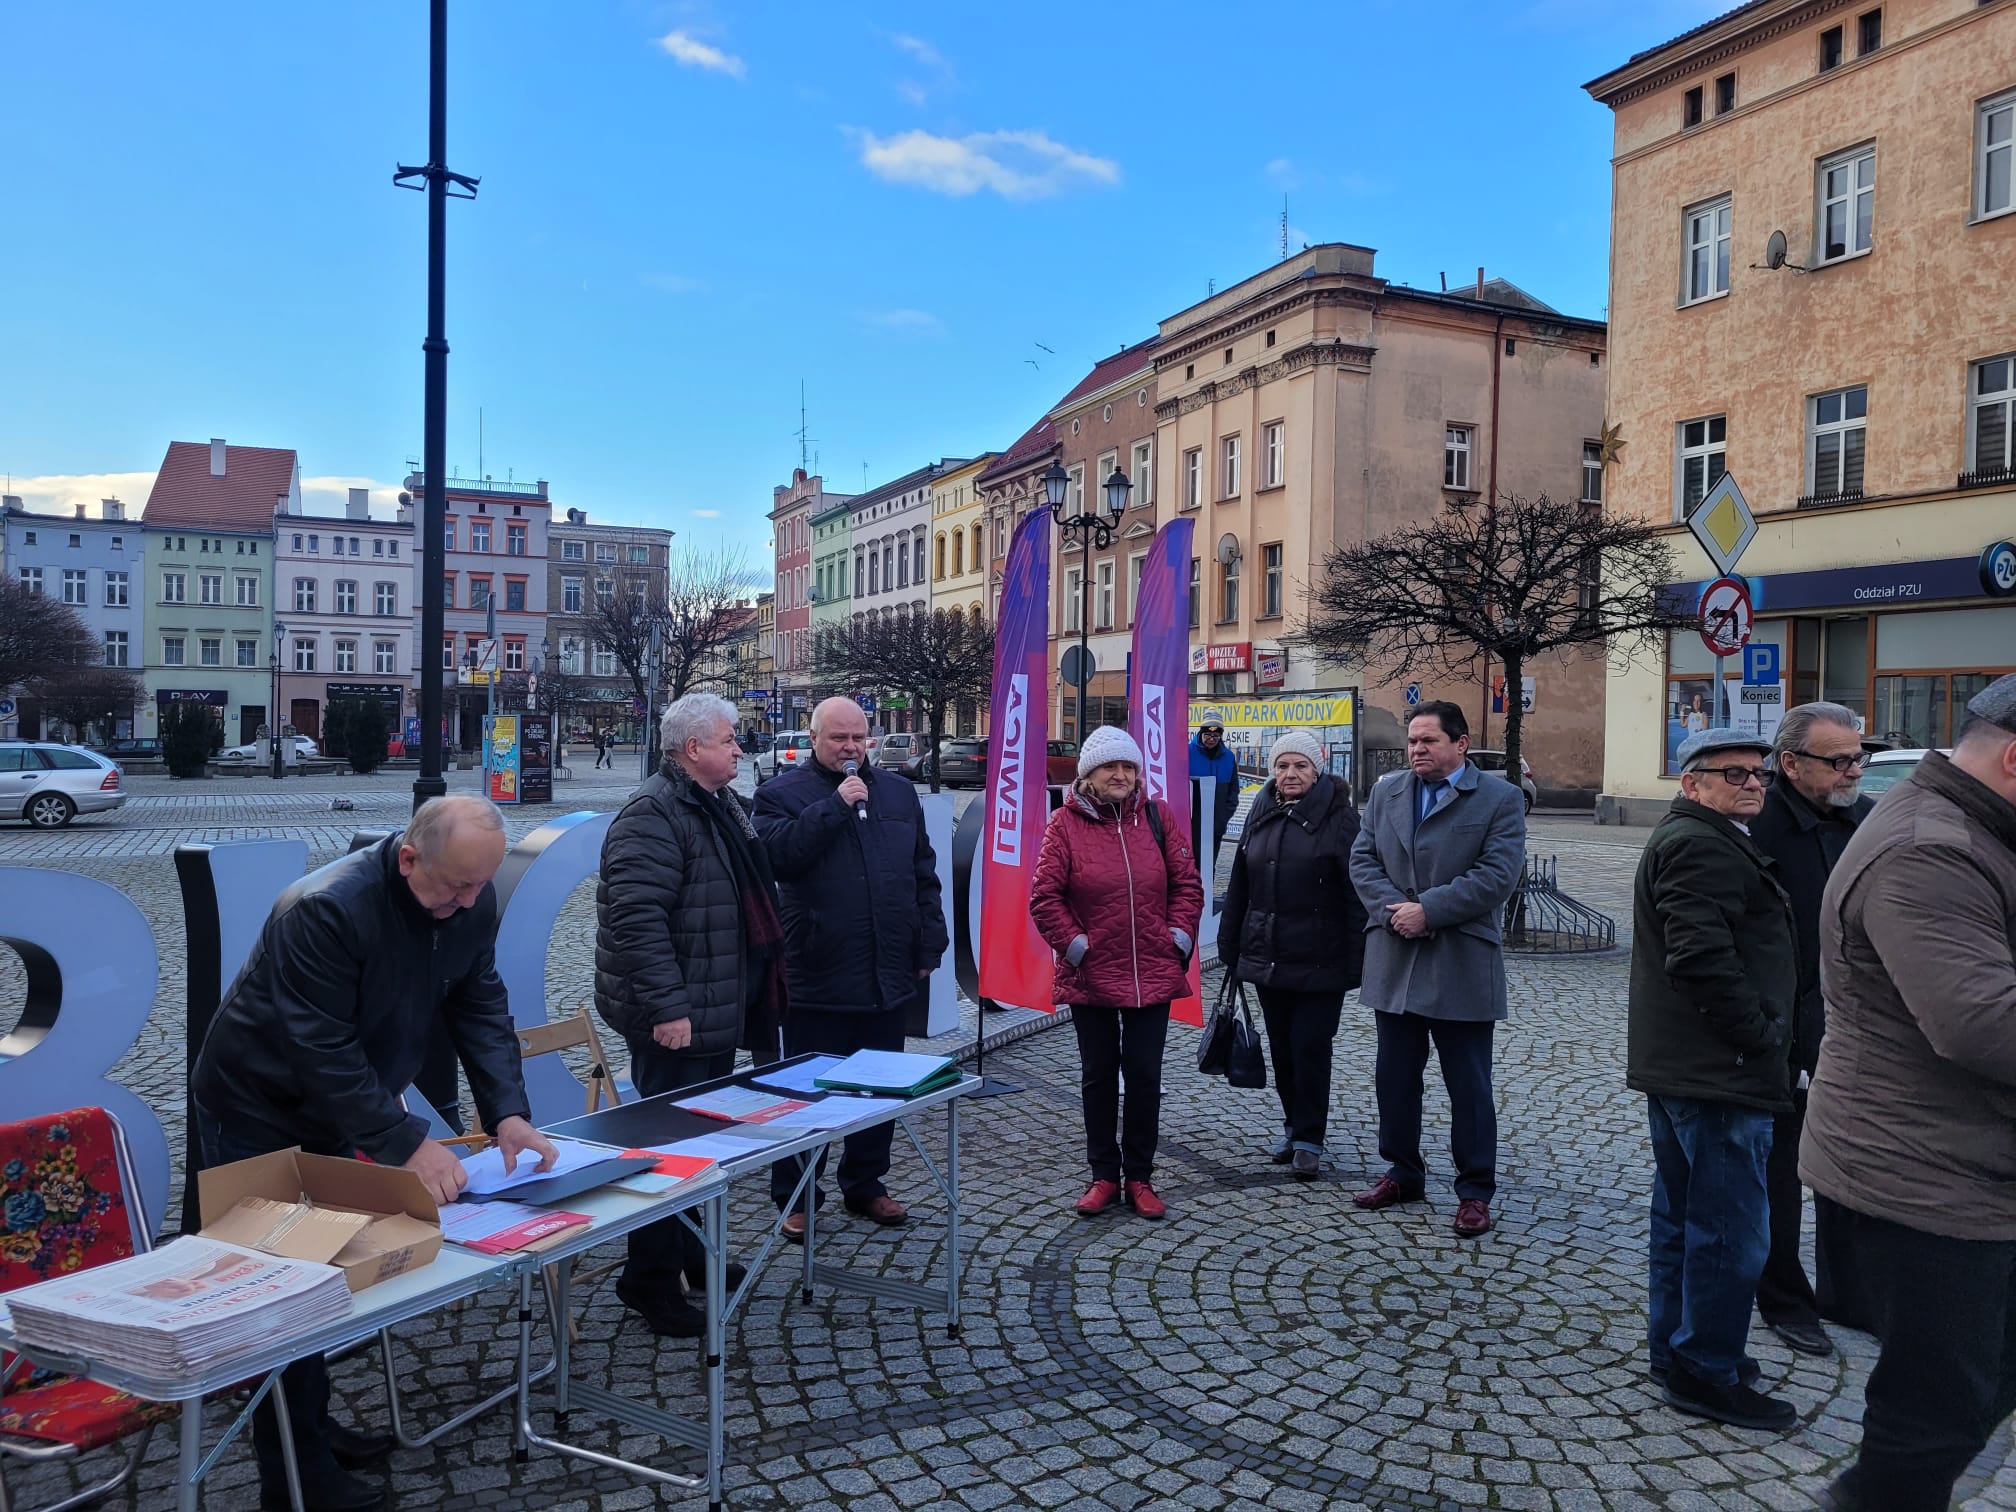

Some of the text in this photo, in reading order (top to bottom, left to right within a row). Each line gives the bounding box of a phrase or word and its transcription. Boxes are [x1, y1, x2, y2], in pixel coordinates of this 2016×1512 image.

[1854, 584, 1922, 599] Oddział PZU
[1214, 657, 1246, 669] OBUWIE
[1263, 659, 1280, 670] MINI
[1263, 667, 1281, 678] MAXI
[170, 692, 211, 700] PLAY
[1742, 690, 1779, 701] Koniec
[1243, 704, 1278, 722] PARK
[1283, 702, 1334, 721] WODNY
[246, 1264, 293, 1286] RENTA
